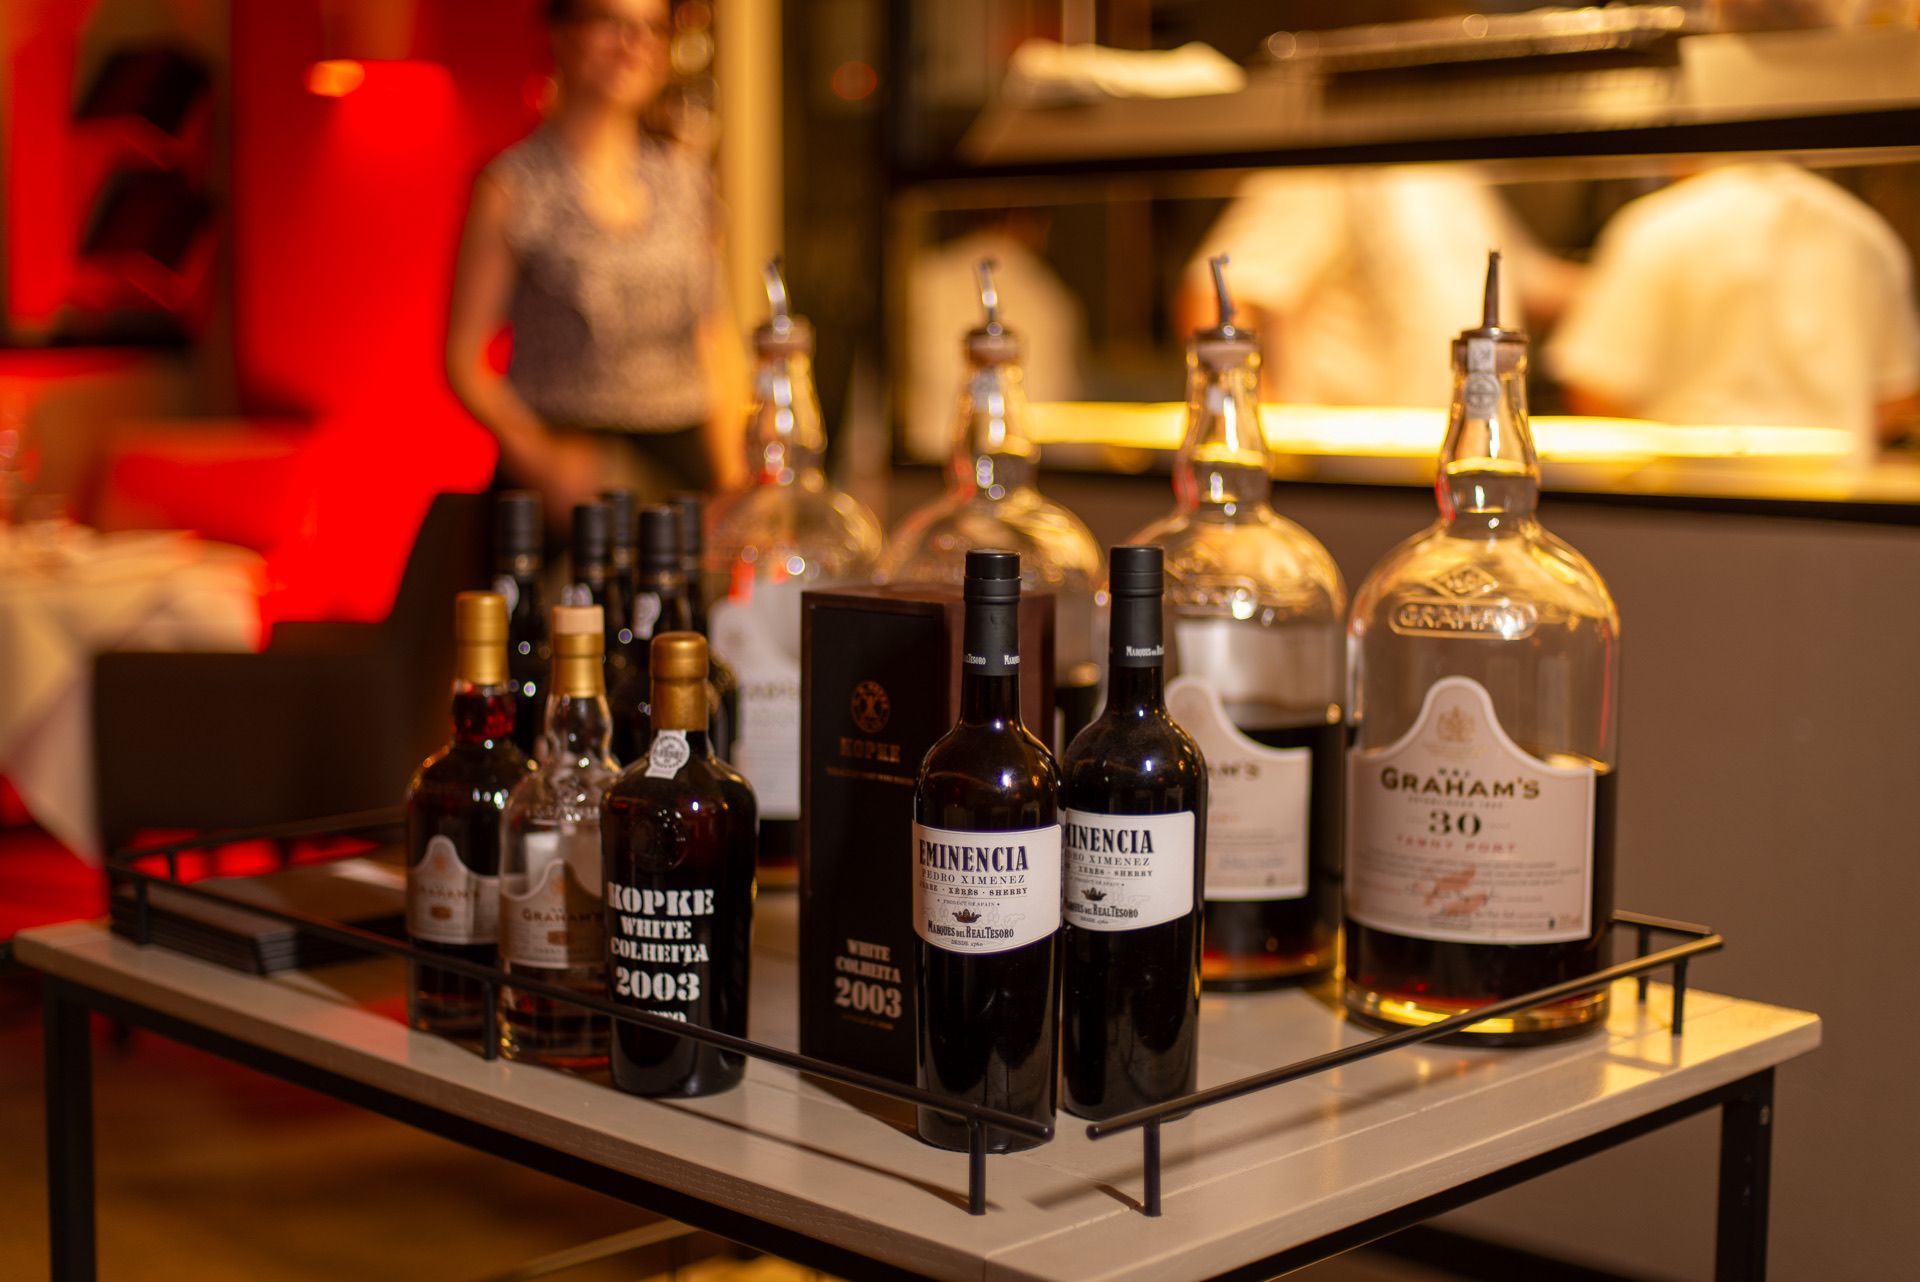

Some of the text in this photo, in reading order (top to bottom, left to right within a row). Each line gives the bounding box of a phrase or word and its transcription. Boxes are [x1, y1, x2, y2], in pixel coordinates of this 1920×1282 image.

[1380, 766, 1540, 799] GRAHAM'S
[1429, 809, 1482, 837] 30
[919, 839, 1029, 872] EMINENCIA
[1089, 854, 1151, 867] XIMENEZ
[921, 868, 1025, 885] PEDRO XIMENEZ
[1114, 869, 1153, 877] SHERRY
[608, 881, 715, 916] KOPKE
[989, 887, 1028, 896] SHERRY
[620, 915, 692, 940] WHITE
[928, 919, 955, 937] MARQUES
[610, 936, 710, 967] COLHEITA
[616, 966, 701, 1001] 2003
[833, 976, 903, 1018] 2003
